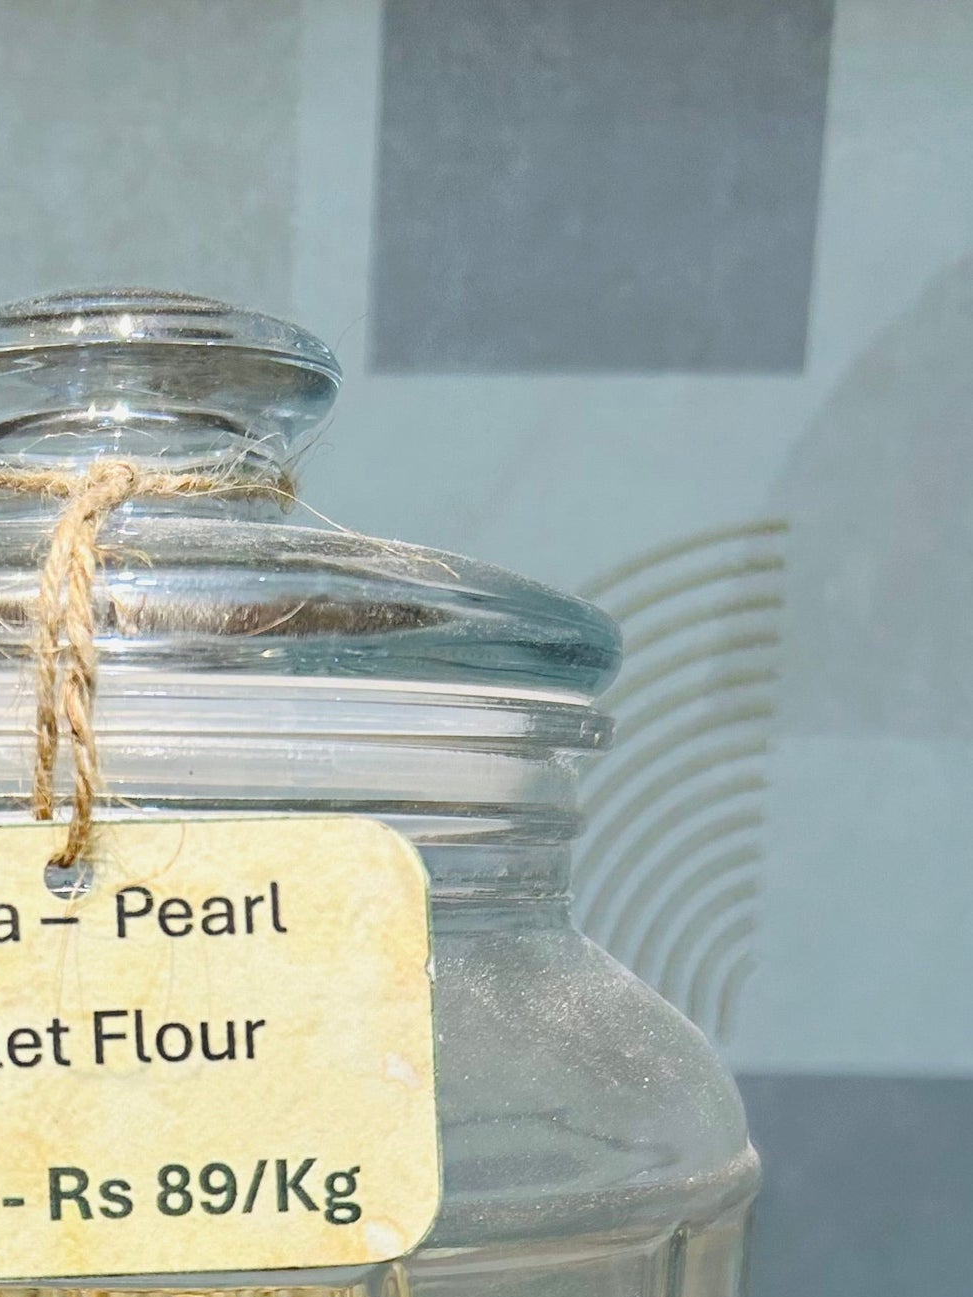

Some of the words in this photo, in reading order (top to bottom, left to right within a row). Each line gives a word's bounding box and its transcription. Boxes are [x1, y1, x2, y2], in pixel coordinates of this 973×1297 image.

[115, 882, 288, 938] Pearl
[93, 1009, 266, 1065] Flour
[48, 1166, 133, 1221] Rs
[157, 1158, 362, 1226] 89/Kg
